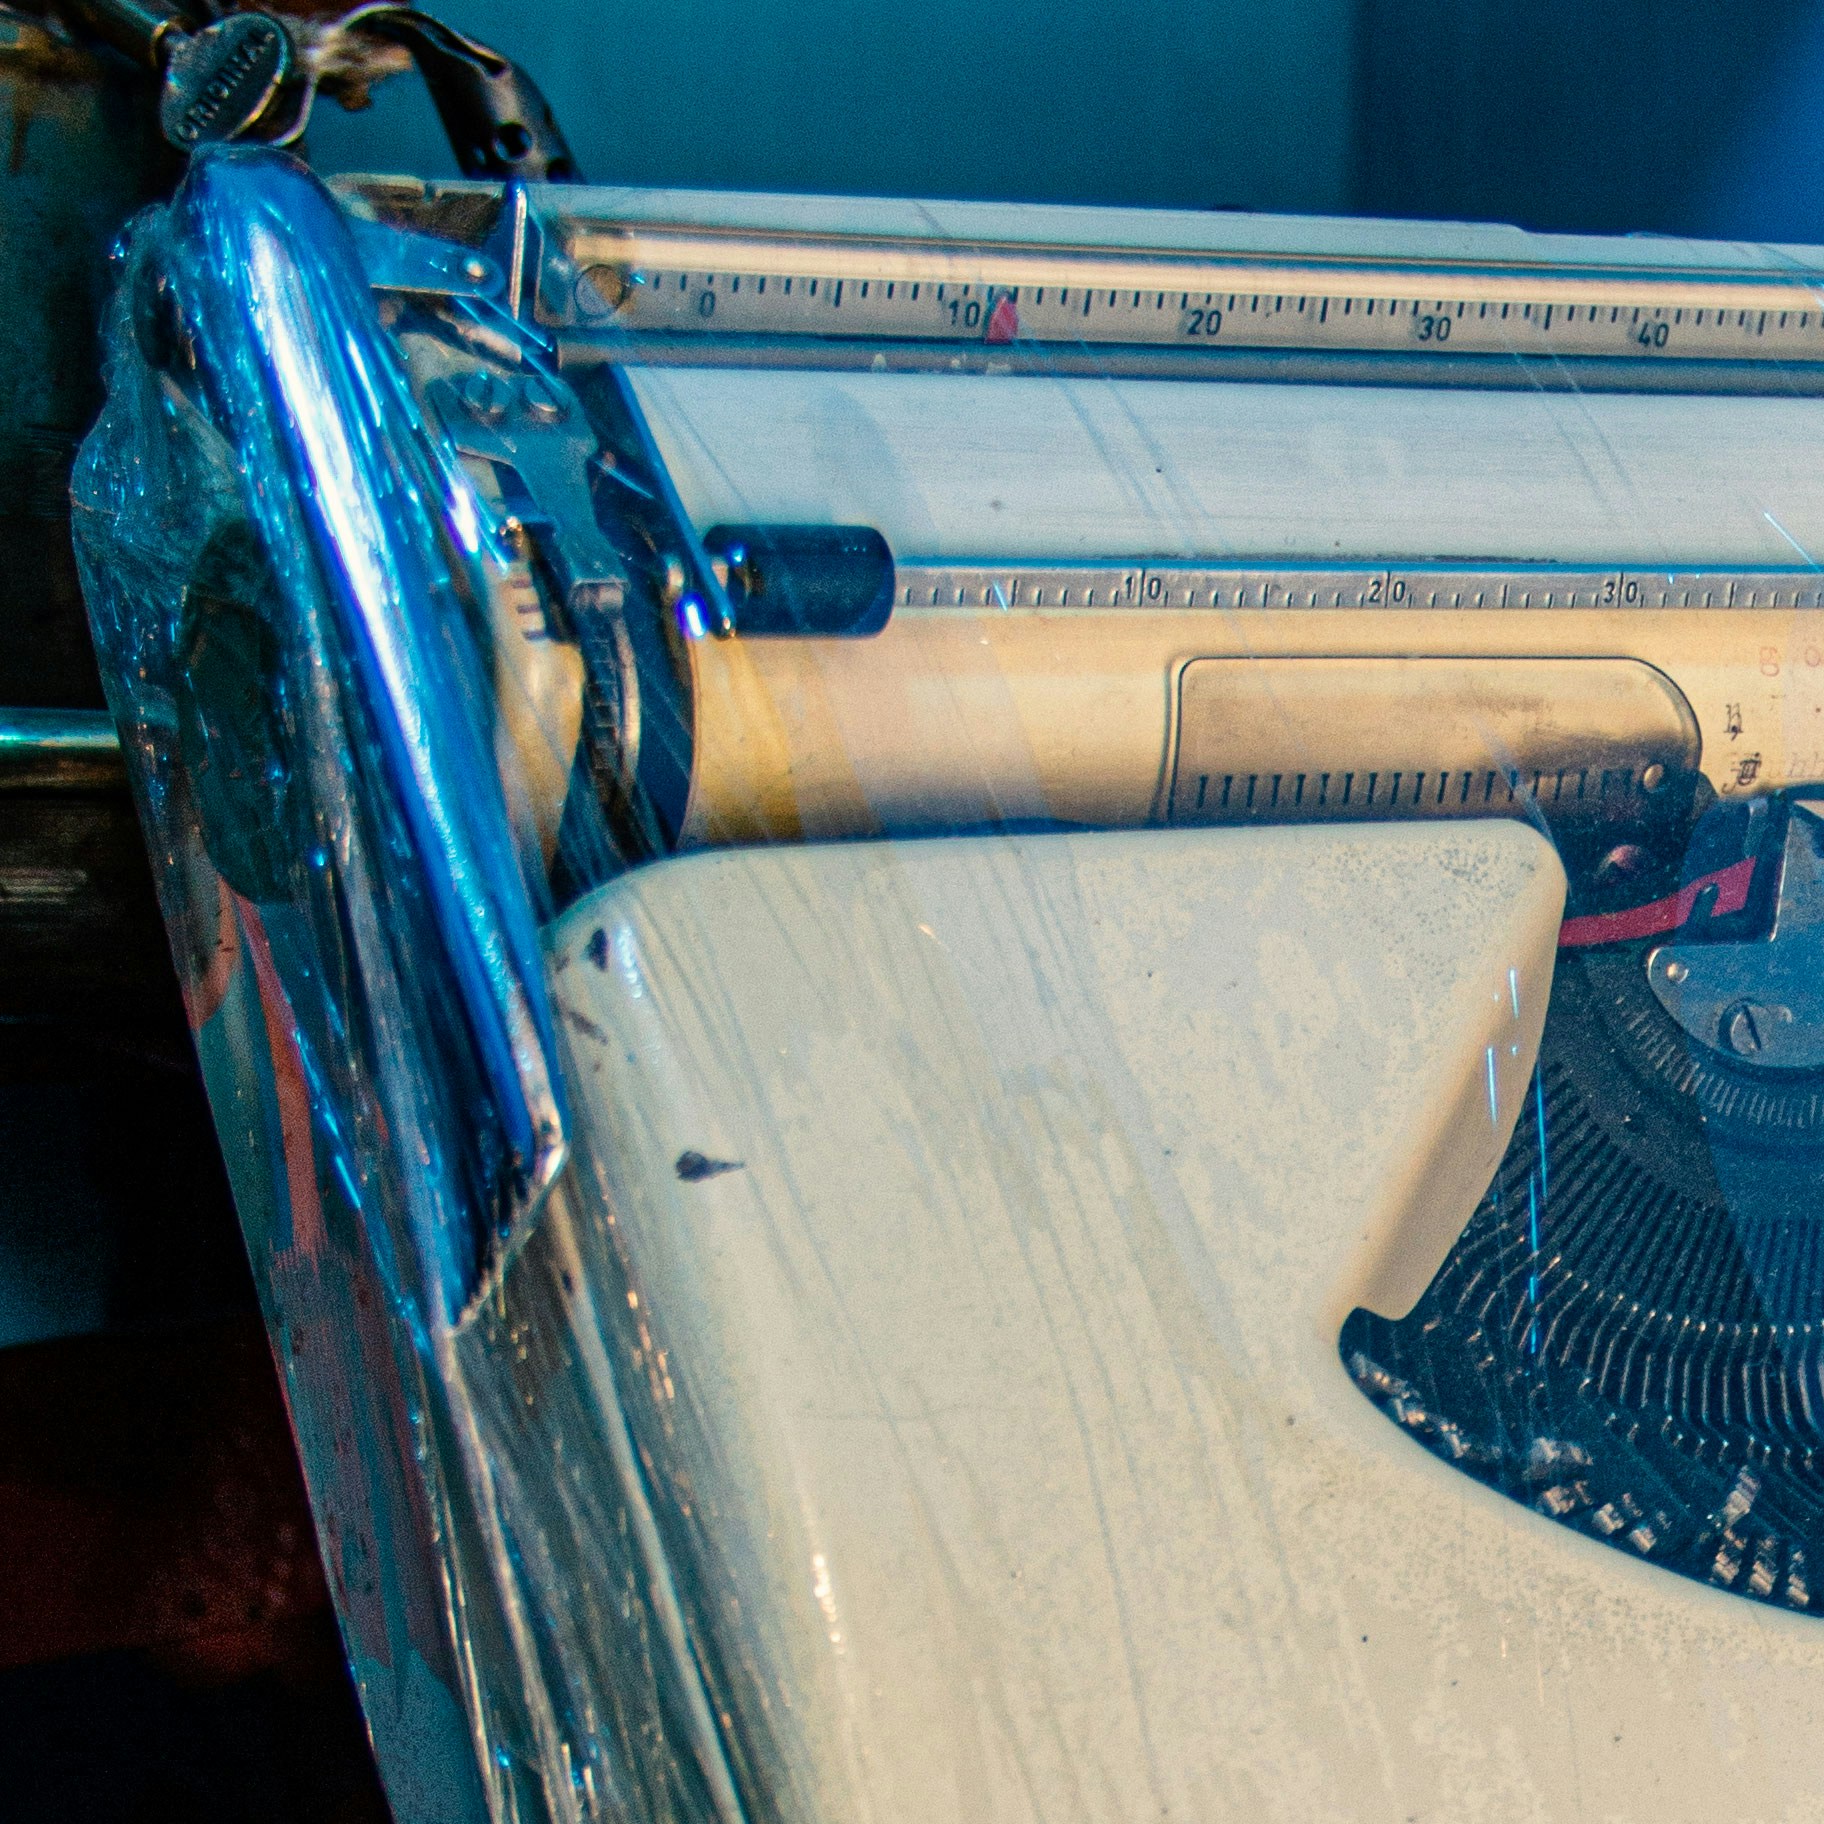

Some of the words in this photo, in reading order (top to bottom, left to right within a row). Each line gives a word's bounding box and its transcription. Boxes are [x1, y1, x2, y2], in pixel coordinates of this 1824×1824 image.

[176, 31, 275, 139] ORIGINAL
[699, 290, 716, 318] 0
[948, 300, 981, 328] 10
[1187, 309, 1223, 336] 20
[1417, 316, 1452, 343] 30
[1636, 322, 1670, 349] 40
